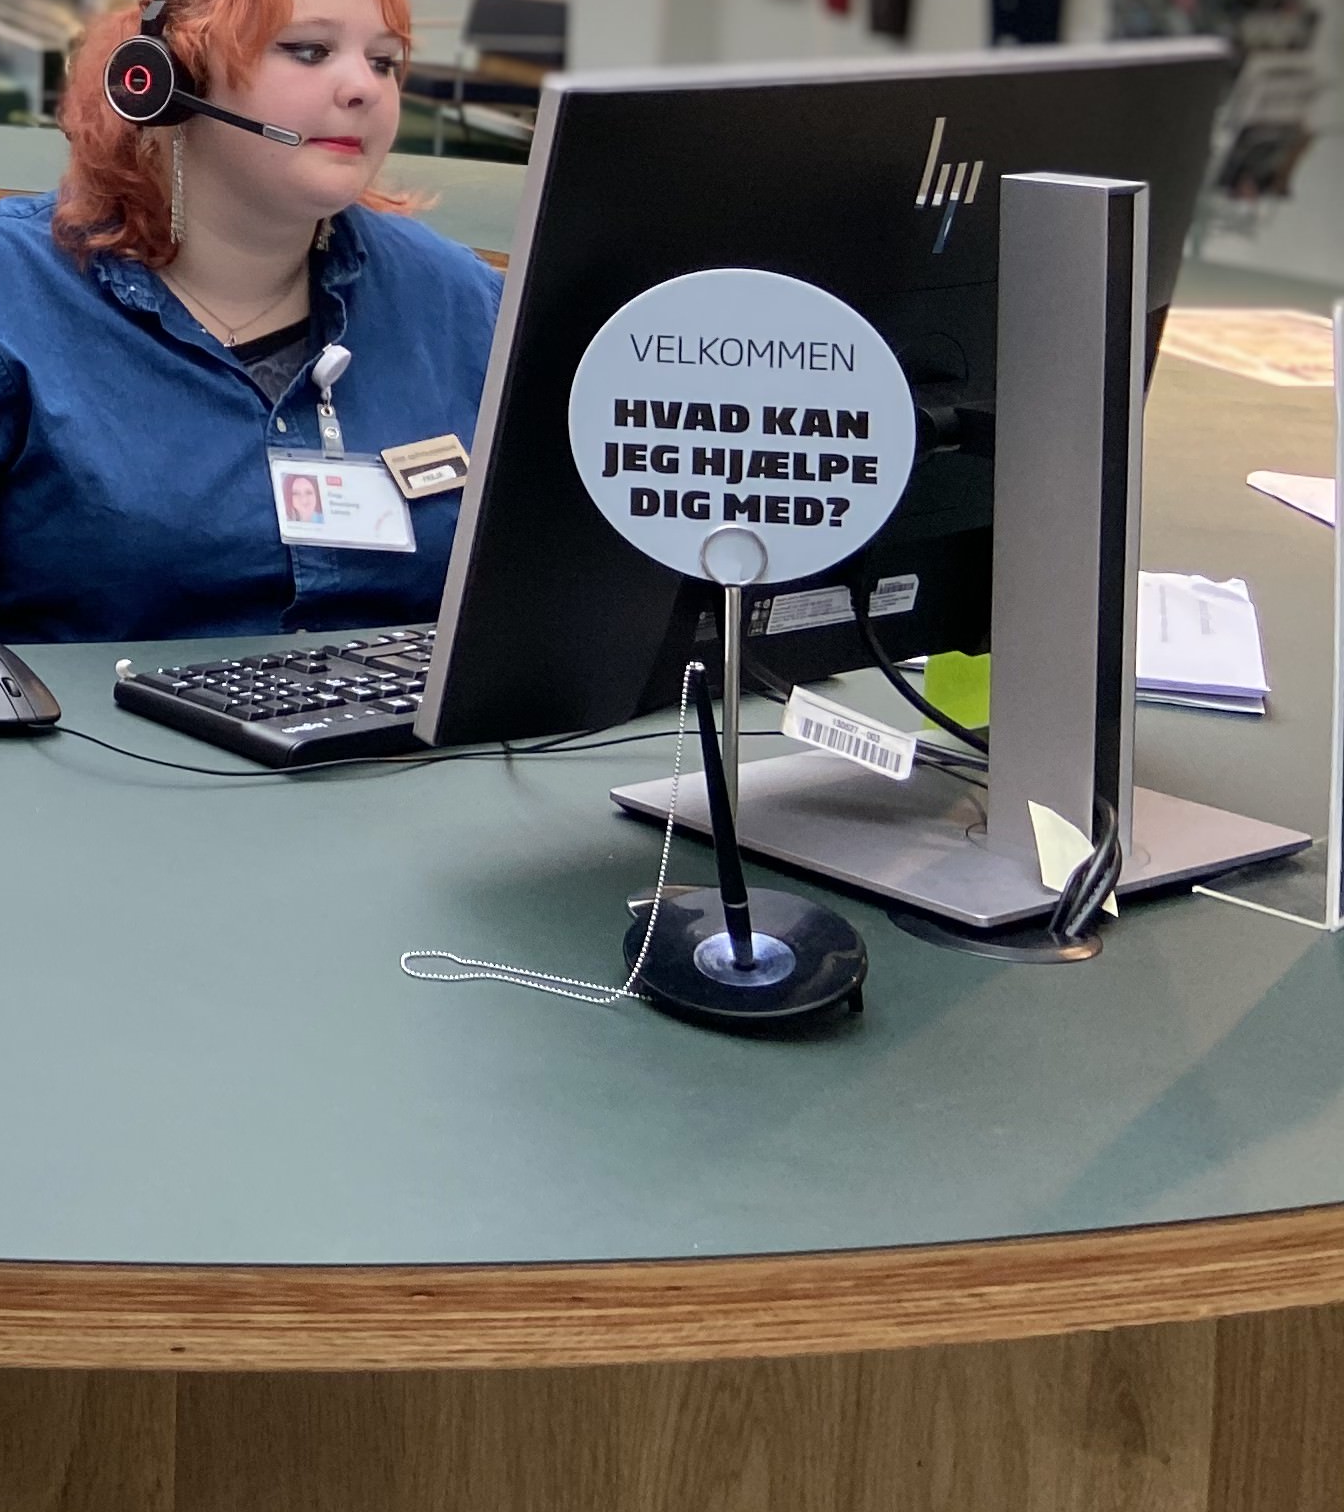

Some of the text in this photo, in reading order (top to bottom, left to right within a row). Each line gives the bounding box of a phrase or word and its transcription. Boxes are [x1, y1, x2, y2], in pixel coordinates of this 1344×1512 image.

[914, 116, 984, 254] hp
[630, 333, 855, 372] VELKOMMEN
[614, 398, 869, 440] HVAD KAN
[602, 442, 879, 485] JEG HJÆLPE
[630, 487, 851, 528] DIG MED?
